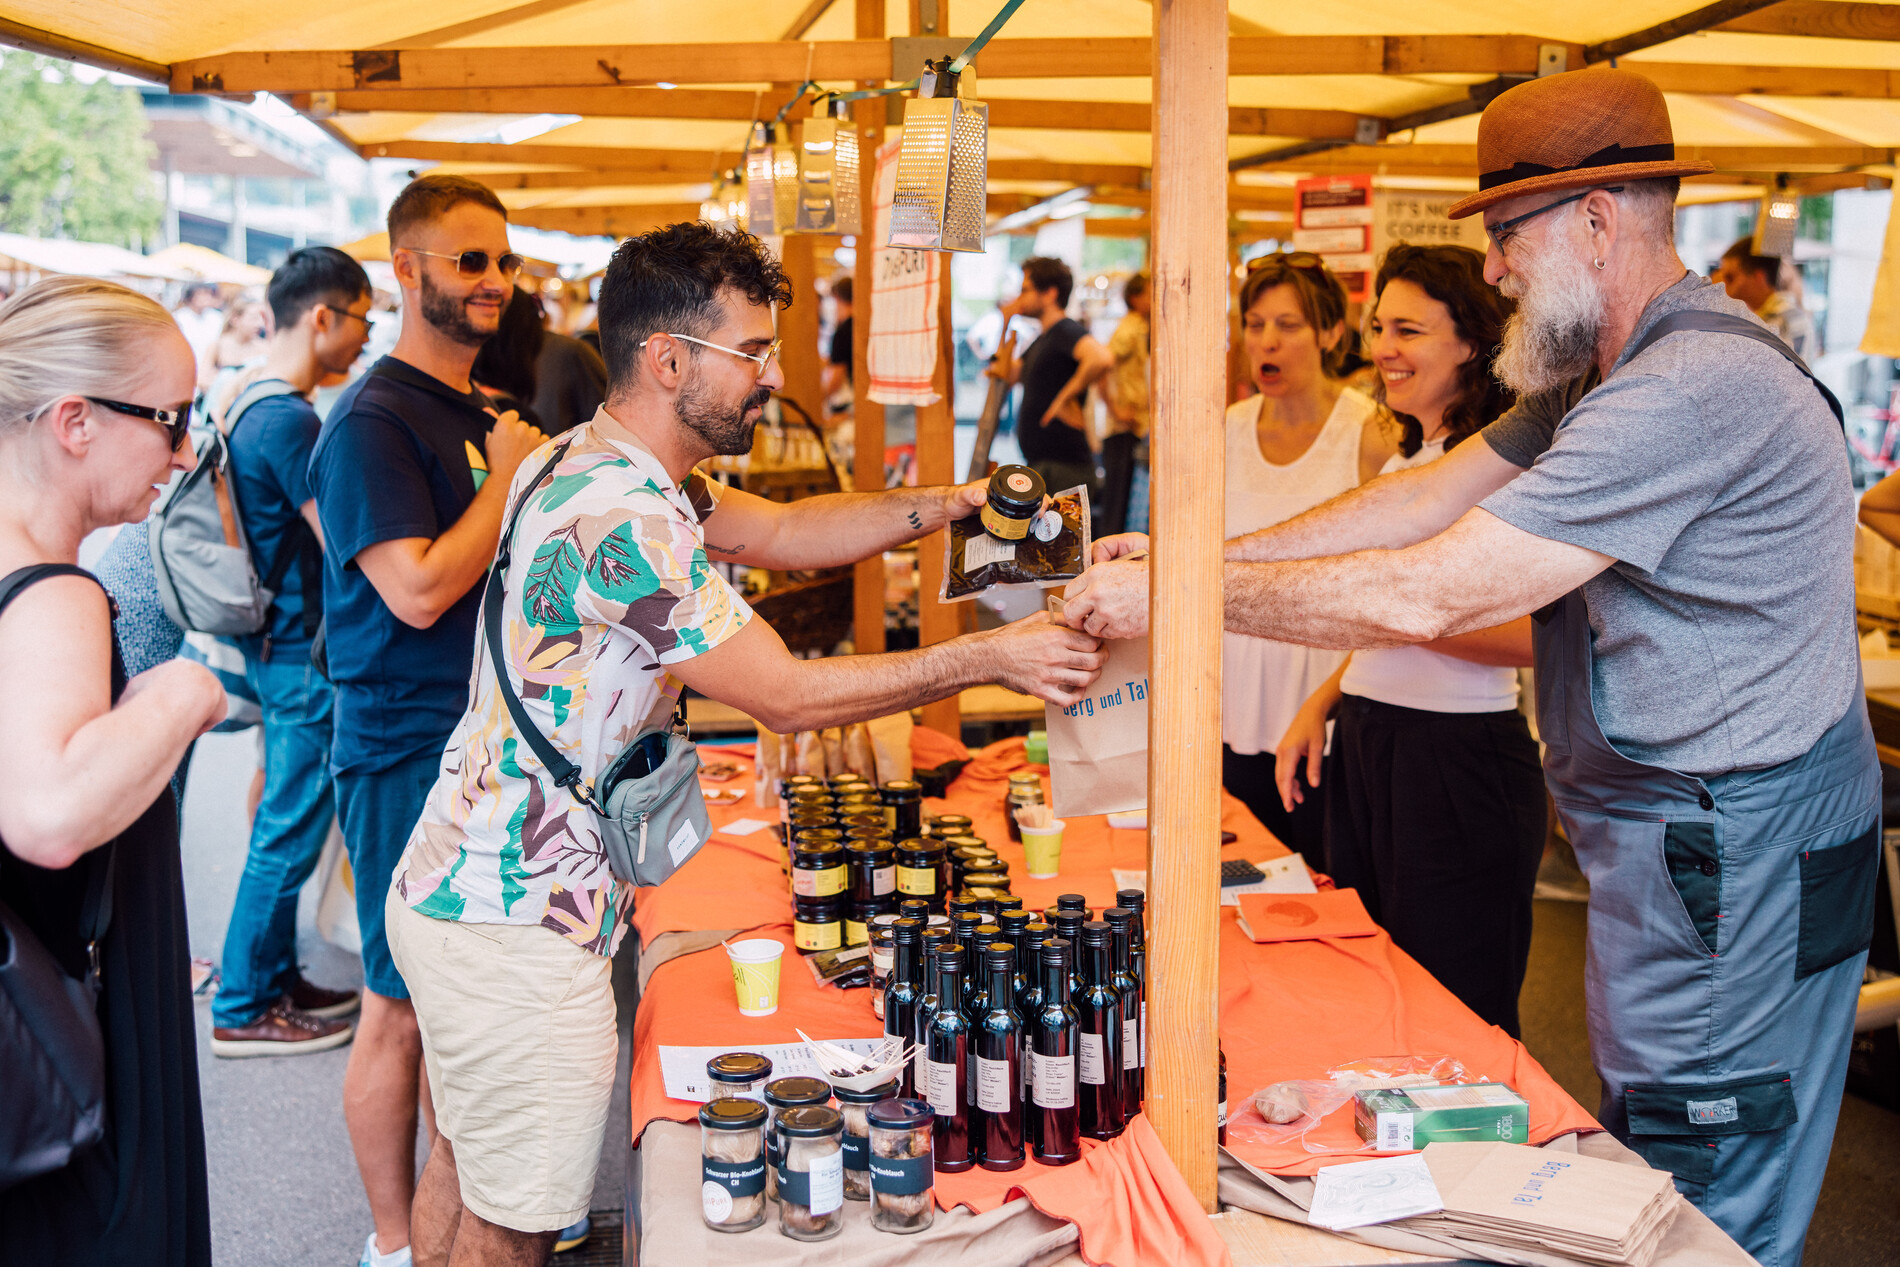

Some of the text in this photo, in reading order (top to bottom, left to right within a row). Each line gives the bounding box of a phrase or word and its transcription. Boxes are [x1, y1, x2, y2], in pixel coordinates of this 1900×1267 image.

[1386, 221, 1460, 239] COFFEE
[1100, 688, 1123, 709] und
[1691, 1105, 1734, 1118] WORKER
[1501, 1114, 1512, 1139] 1800
[705, 1167, 729, 1178] Schwarzer
[730, 1165, 764, 1179] Bio-Knoblauch
[1530, 1161, 1571, 1178] Berg
[1511, 1194, 1543, 1207] Tal
